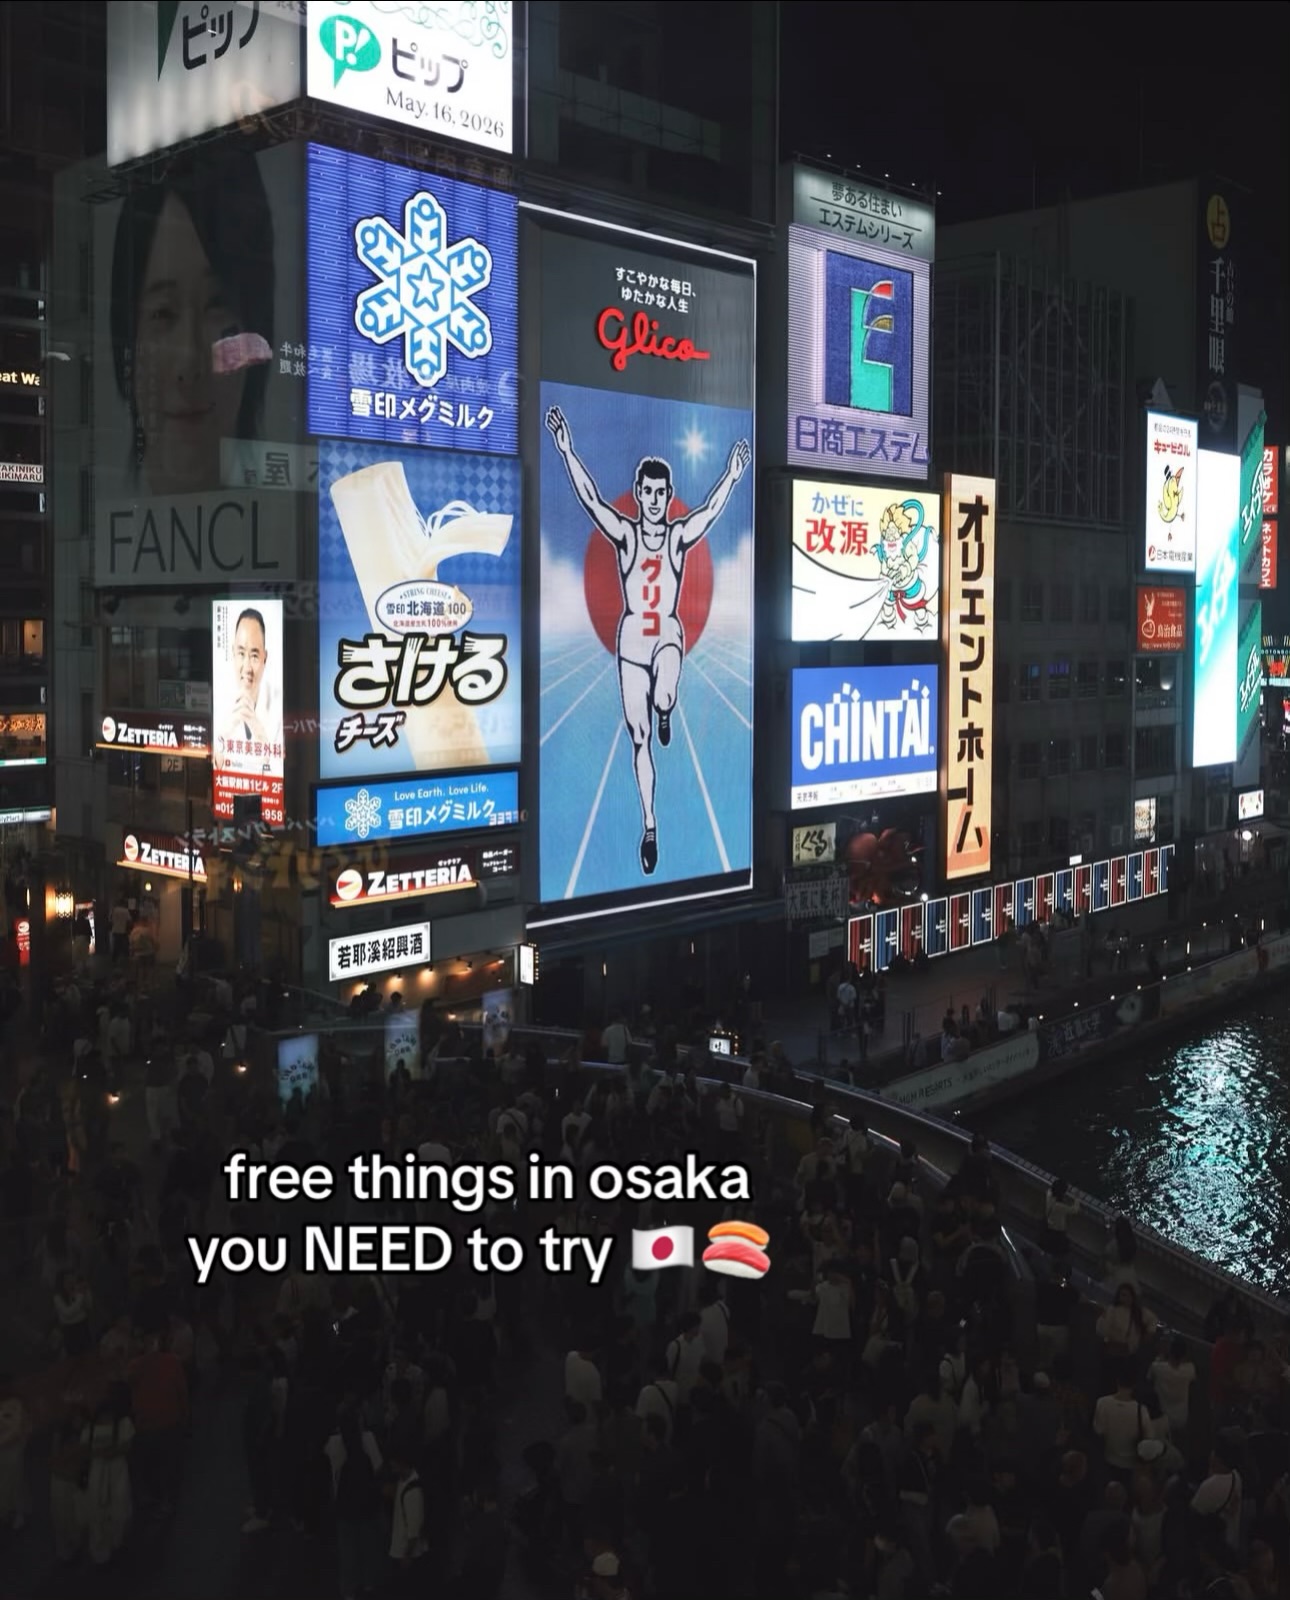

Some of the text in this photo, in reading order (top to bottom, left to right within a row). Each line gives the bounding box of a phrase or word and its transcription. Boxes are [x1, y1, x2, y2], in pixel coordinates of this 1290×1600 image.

[391, 37, 468, 94] ピップ
[459, 109, 505, 139] 2026
[832, 181, 903, 218] 夢ある住まい
[819, 207, 914, 250] エステムシリーズ
[615, 266, 697, 298] すこやかな毎日、
[621, 286, 689, 314] ゆたかな人生
[1208, 256, 1225, 375] 千里眼
[596, 306, 711, 372] Glico
[349, 388, 494, 431] 雪印メグミルク
[796, 414, 930, 465] 日商エステム
[1263, 448, 1274, 504] カラオケ
[812, 492, 864, 516] かぜに
[109, 501, 280, 574] FANCL
[805, 517, 869, 557] 改源
[641, 554, 663, 637] グリコ
[336, 632, 507, 708] さける
[951, 494, 990, 853] オリエントホーム
[117, 723, 179, 749] ZETTERIA
[226, 738, 282, 758] 東京美容外科
[335, 712, 405, 753] チーズ
[395, 782, 489, 802] Love Earth. Love Life.
[387, 798, 496, 831] 雪印メグミルク
[140, 842, 206, 875] ZETTERIA
[367, 864, 473, 897] ZETTERIA
[337, 932, 423, 970] 若耶溪紹興酒
